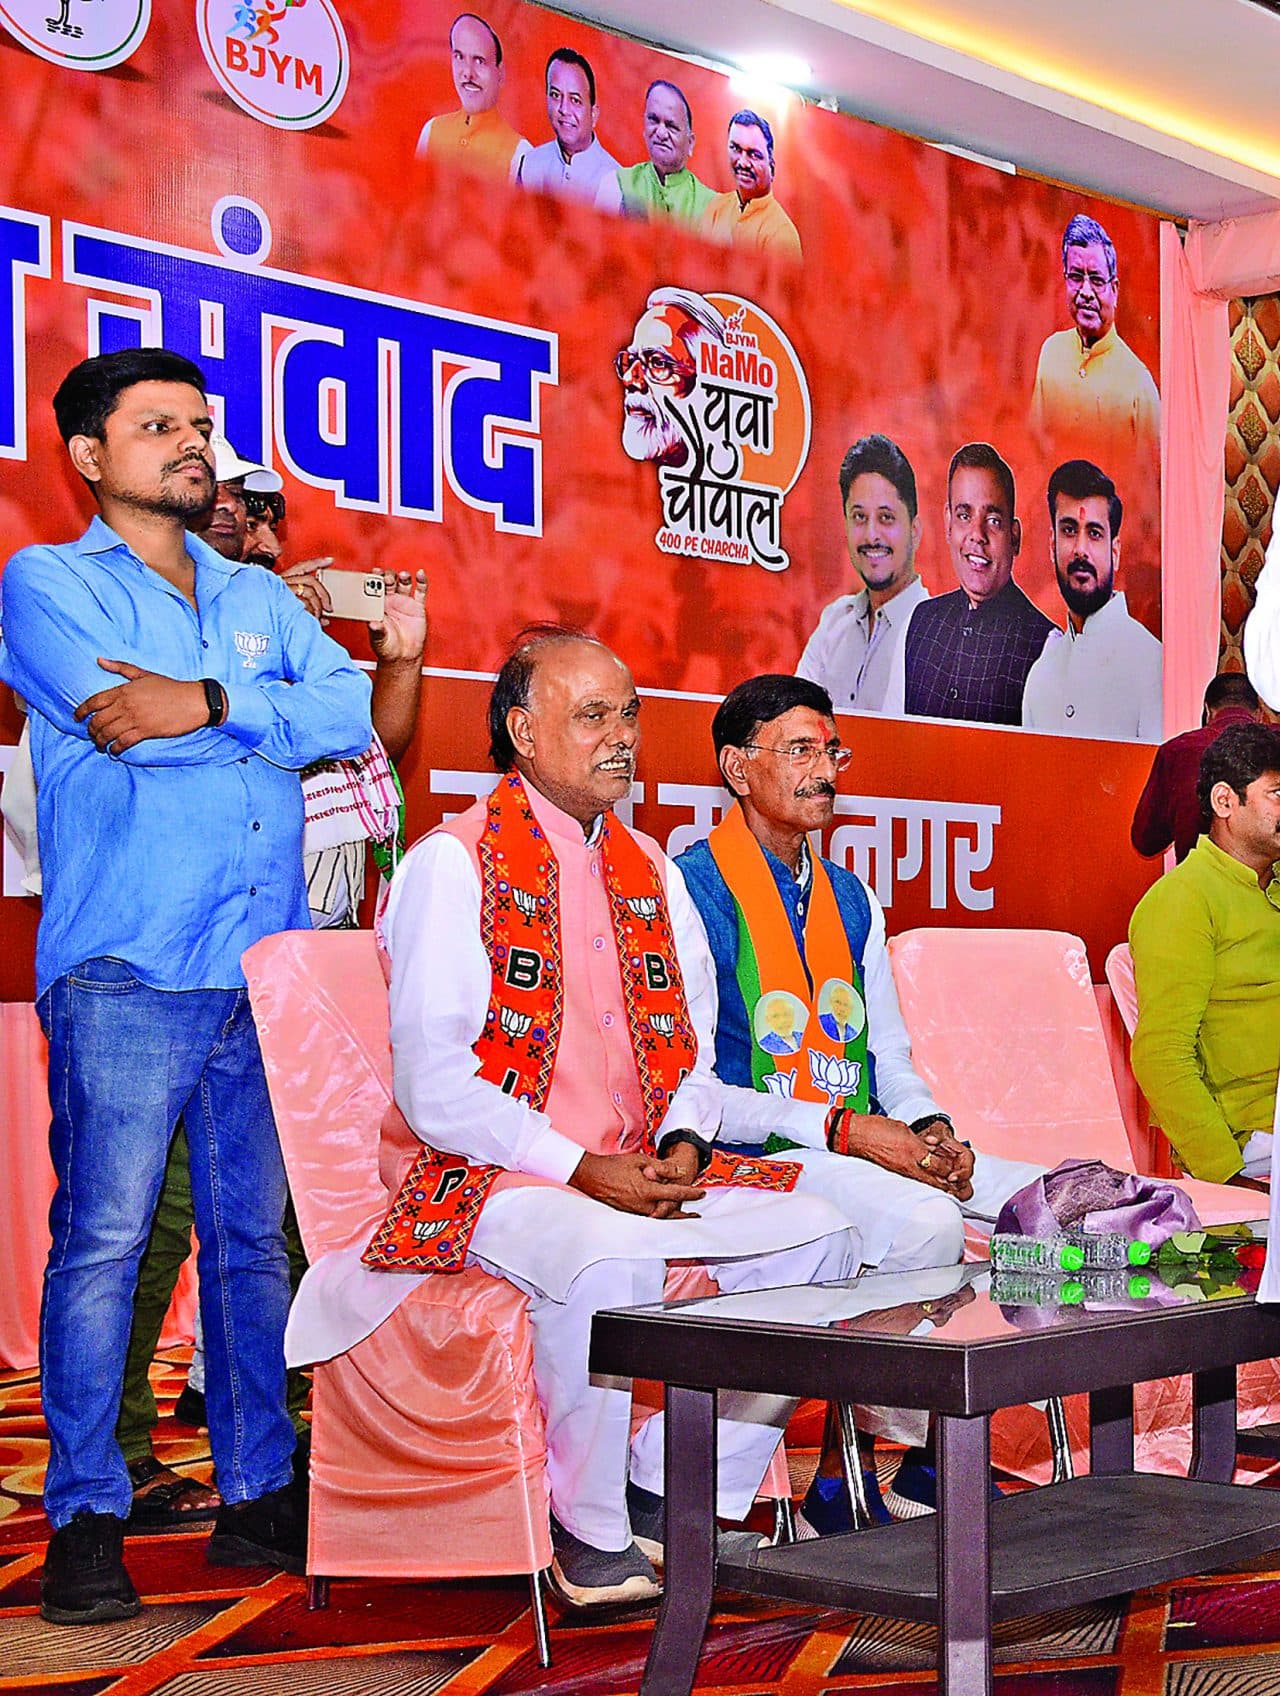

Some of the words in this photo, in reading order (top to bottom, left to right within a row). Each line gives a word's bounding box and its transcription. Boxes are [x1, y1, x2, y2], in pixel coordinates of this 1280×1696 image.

[226, 36, 323, 96] BJYM
[725, 332, 756, 349] BJYM
[700, 341, 773, 388] NaMo
[701, 382, 773, 480] युवा
[660, 532, 681, 549] 400
[684, 536, 699, 551] PE
[700, 538, 749, 559] CHARCHA
[505, 946, 543, 990] B
[643, 952, 669, 990] B
[430, 1167, 468, 1204] P
